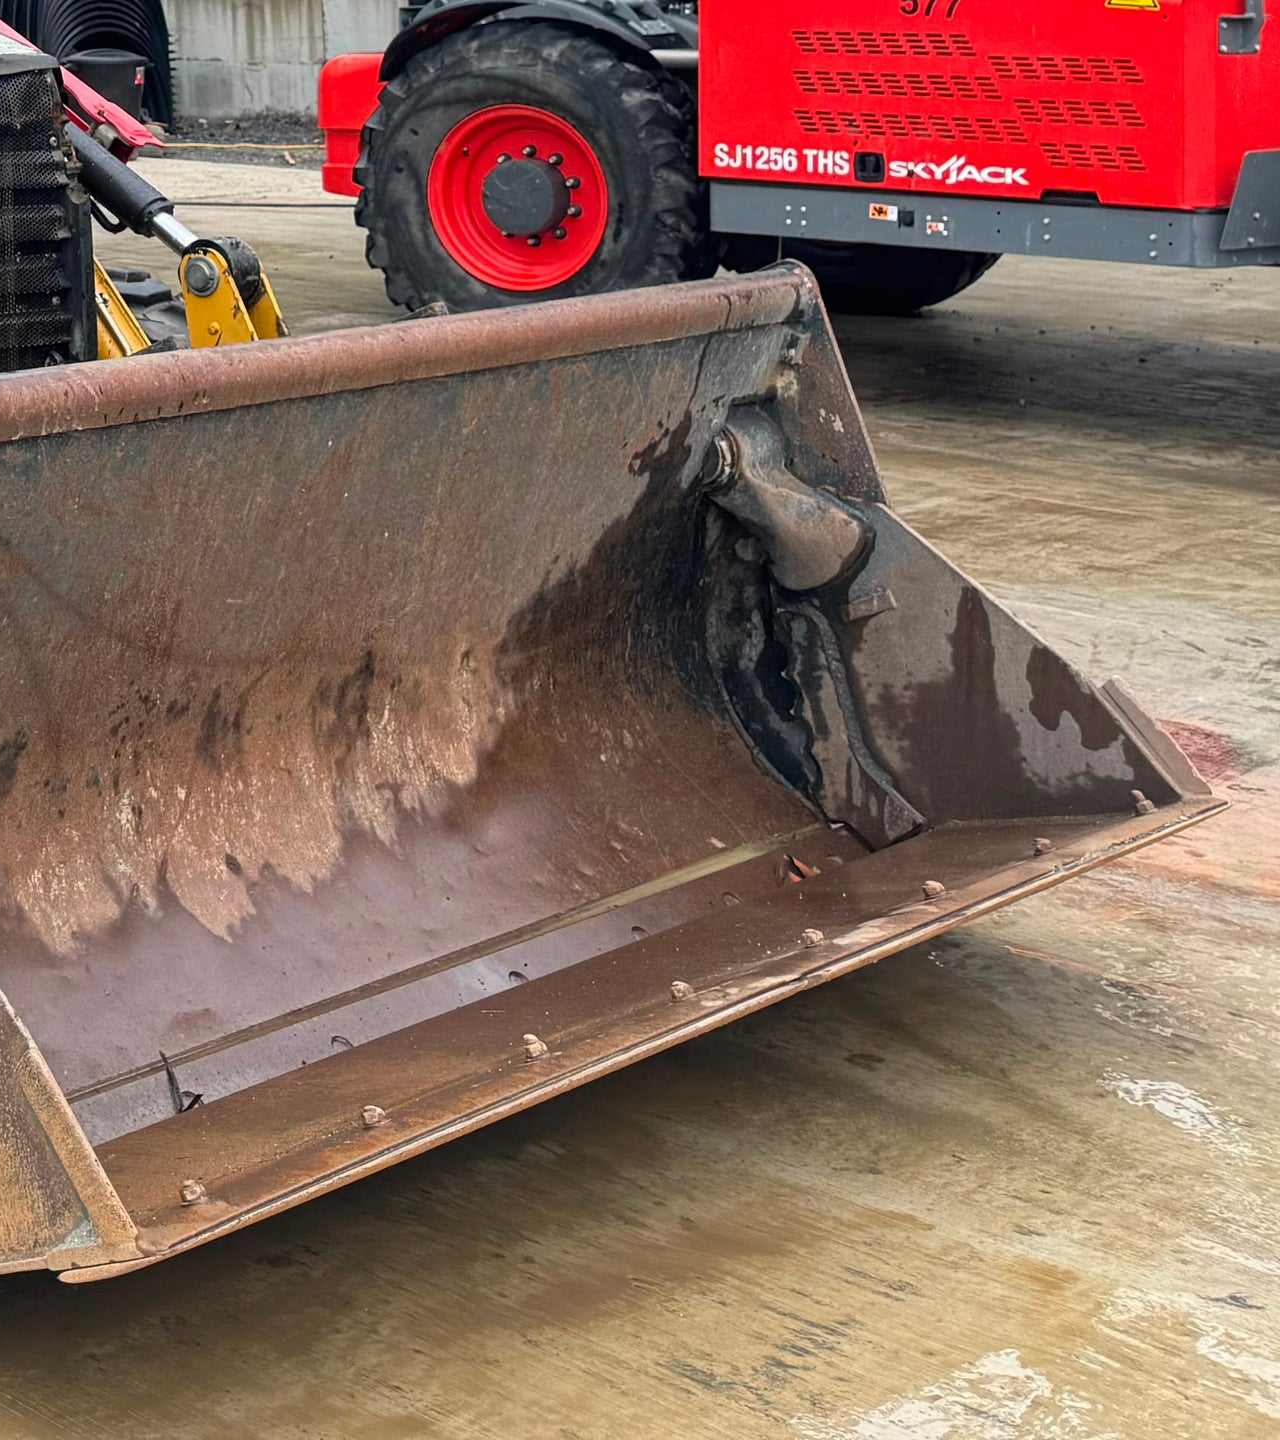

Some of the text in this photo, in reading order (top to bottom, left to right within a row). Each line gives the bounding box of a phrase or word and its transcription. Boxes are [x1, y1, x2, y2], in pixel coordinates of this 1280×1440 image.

[713, 143, 850, 175] SJ1256 THS
[889, 155, 1029, 185] SKYJACK
